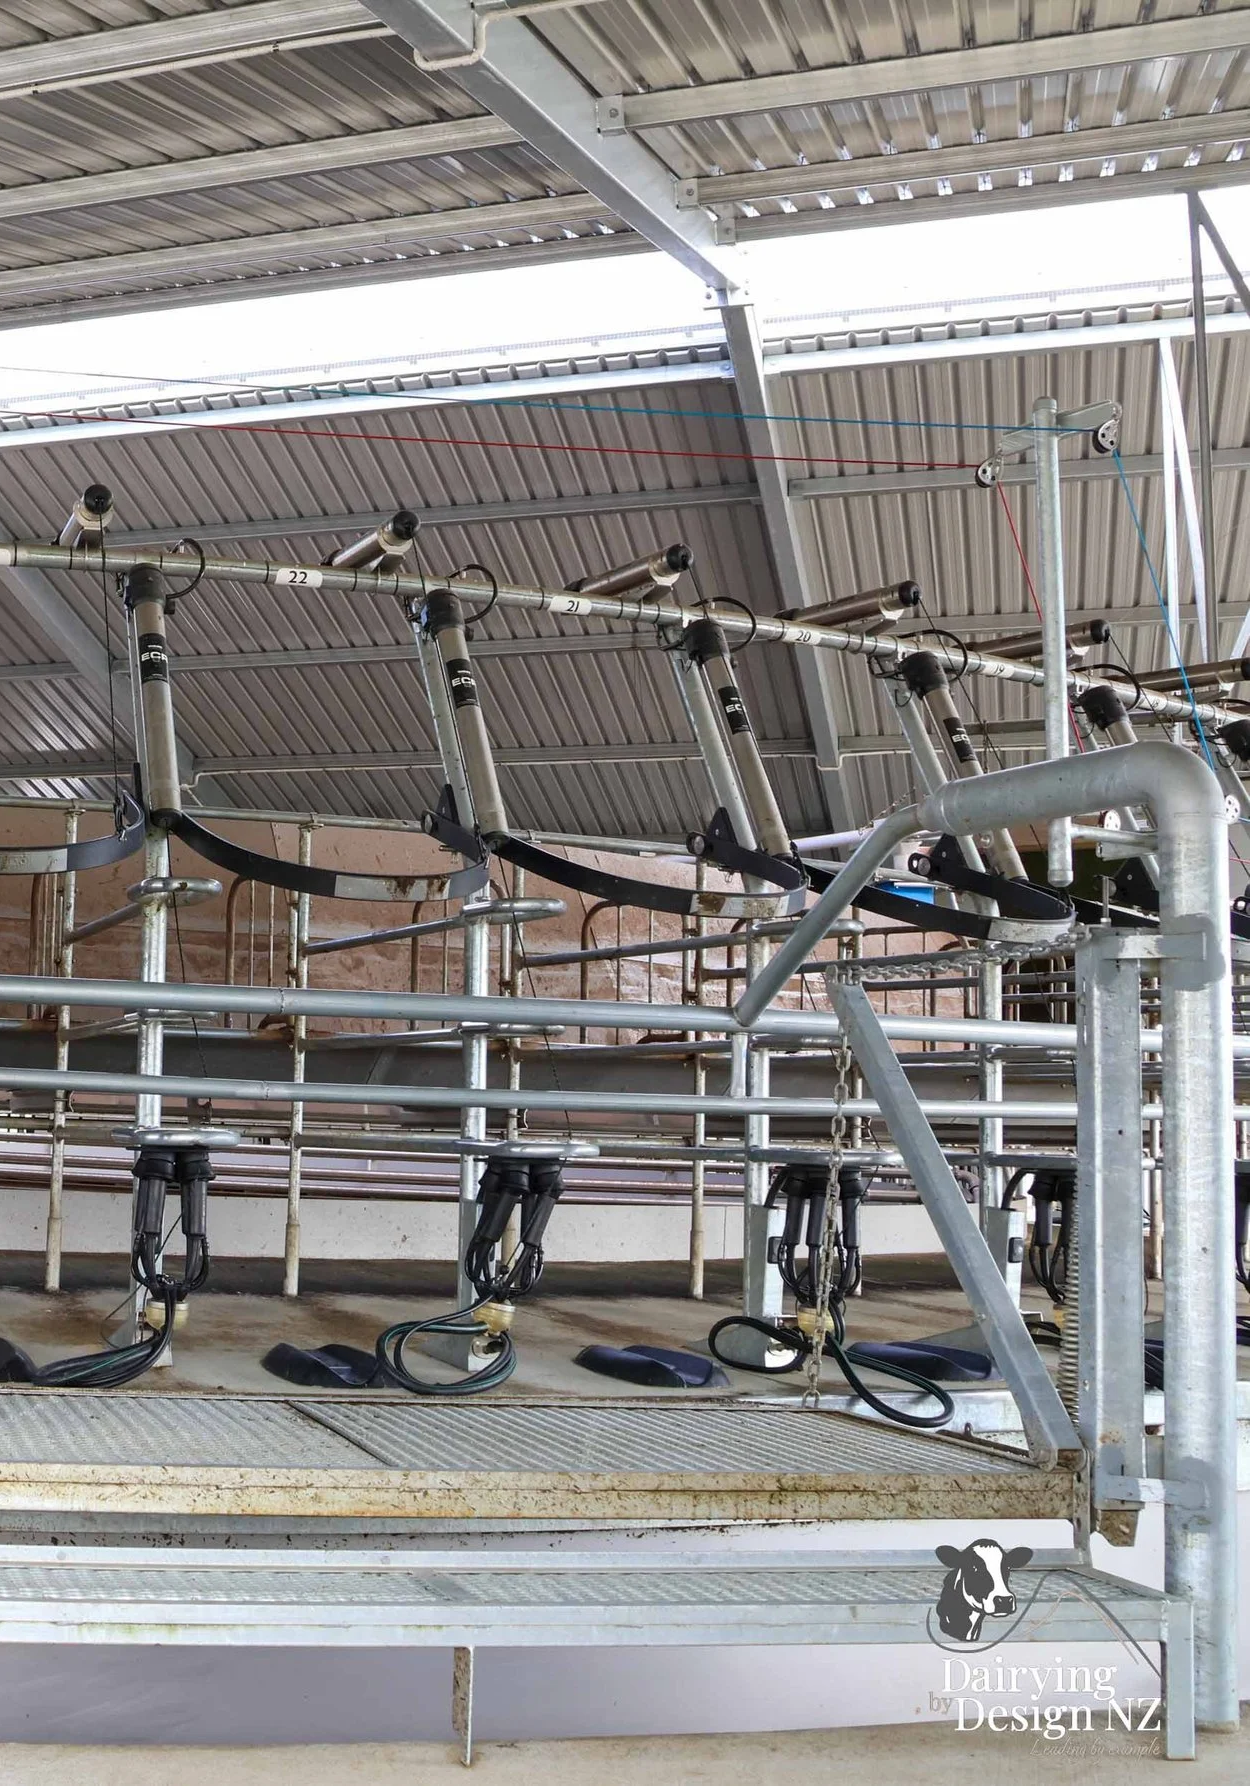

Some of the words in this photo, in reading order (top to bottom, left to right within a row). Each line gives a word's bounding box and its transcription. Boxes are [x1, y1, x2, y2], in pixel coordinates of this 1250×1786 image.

[288, 570, 308, 584] 22
[565, 600, 580, 613] 21
[795, 629, 812, 643] 20
[141, 651, 169, 664] ECR
[993, 663, 1006, 675] 19
[725, 703, 744, 714] EC
[951, 733, 971, 745] EC
